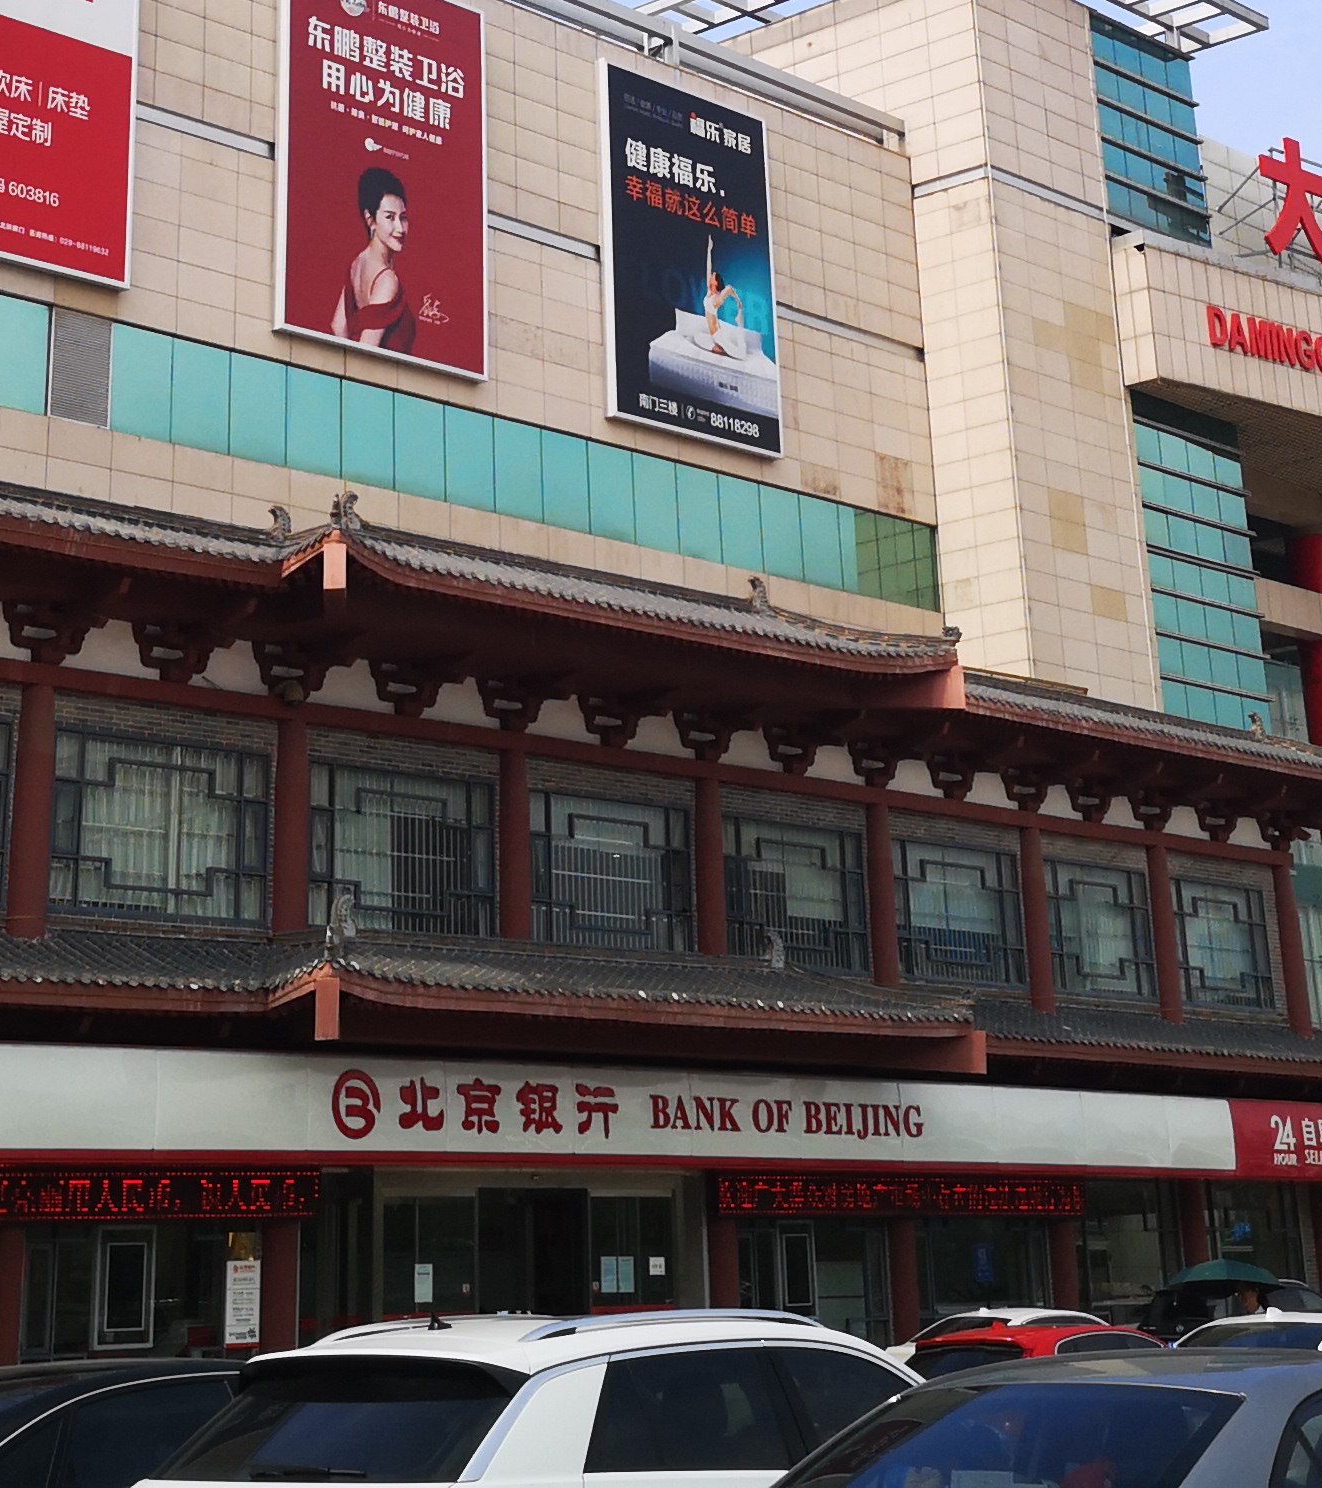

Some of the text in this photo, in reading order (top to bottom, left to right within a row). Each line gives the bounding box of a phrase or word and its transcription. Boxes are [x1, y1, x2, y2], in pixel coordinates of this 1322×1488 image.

[307, 15, 466, 100] 东鹏整装卫浴
[321, 58, 453, 131] 用心为健康
[8, 181, 60, 208] 603816
[624, 174, 758, 240] 幸福就这么简单
[710, 412, 761, 438] 88118298
[398, 1076, 620, 1139] 北京银行
[650, 1093, 925, 1139] BANK OF BEIJING
[1270, 1114, 1297, 1151] 24
[1273, 1152, 1298, 1166] HOUR
